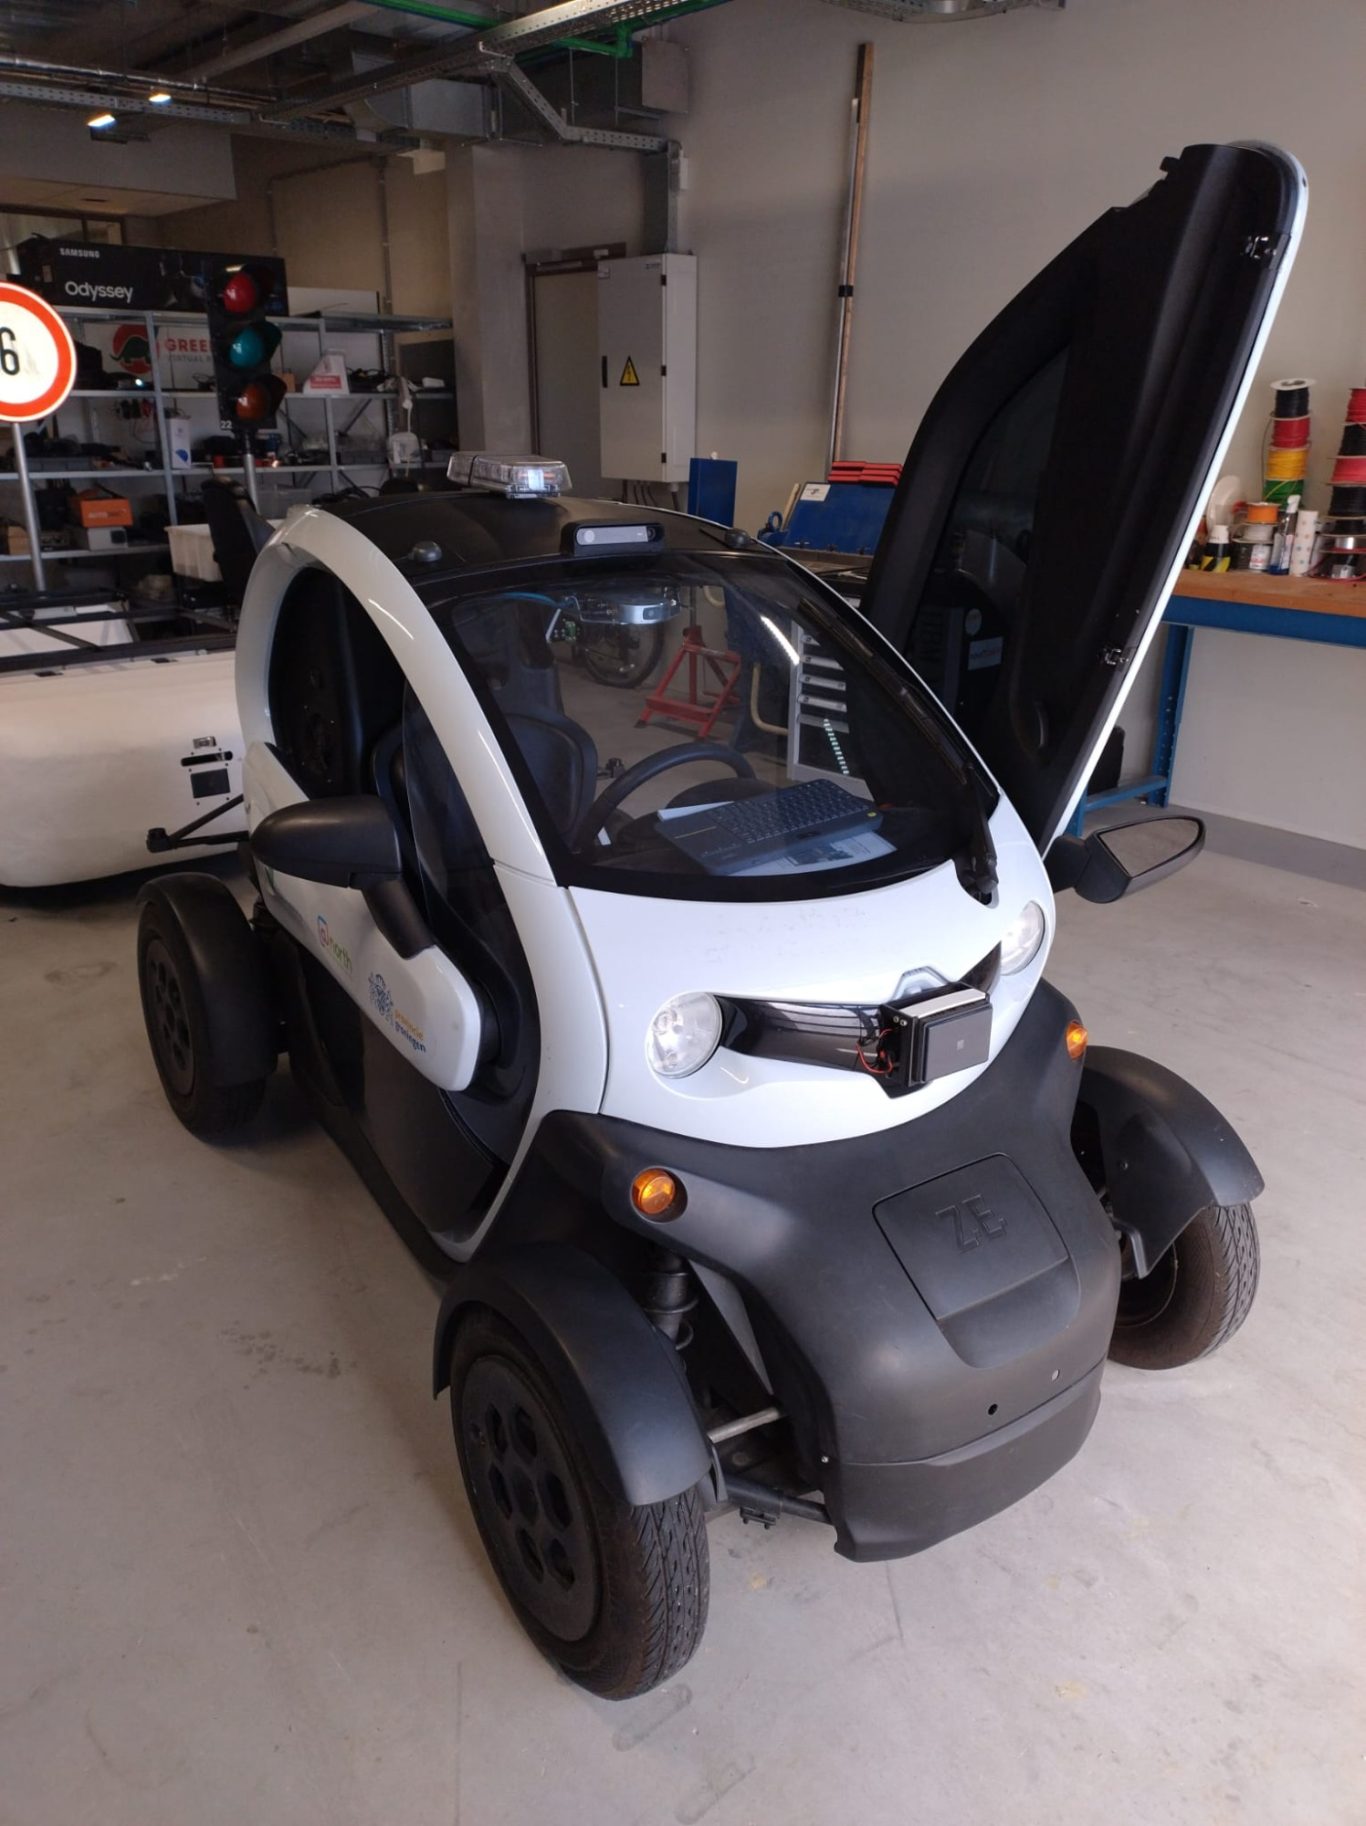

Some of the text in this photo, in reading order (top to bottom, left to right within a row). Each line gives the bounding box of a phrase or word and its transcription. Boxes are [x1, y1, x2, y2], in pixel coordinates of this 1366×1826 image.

[60, 247, 100, 259] SAMSUNG
[65, 281, 134, 303] Odyssey
[164, 338, 210, 352] GREE
[935, 1193, 1008, 1254] ZE
